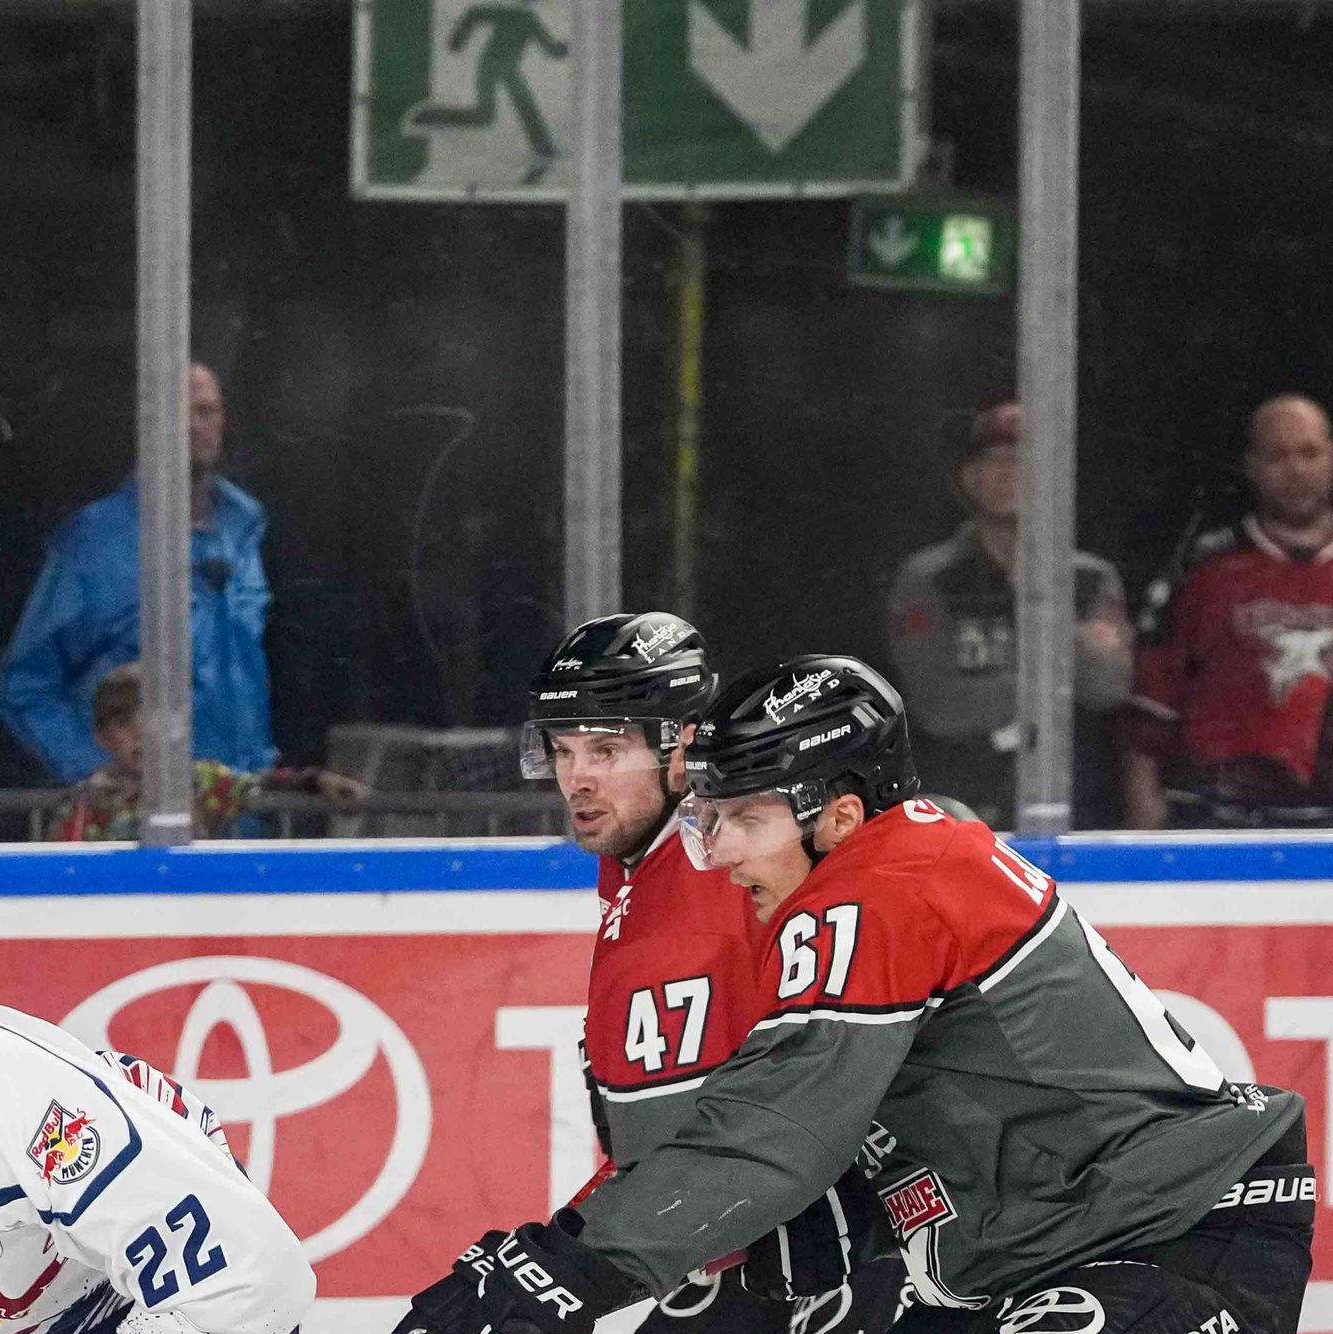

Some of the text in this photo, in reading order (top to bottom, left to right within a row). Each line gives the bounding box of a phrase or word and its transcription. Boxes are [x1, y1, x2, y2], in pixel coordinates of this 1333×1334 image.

[540, 690, 578, 700] BAUER
[670, 675, 700, 687] BAUER
[763, 668, 832, 720] Phantasia
[799, 724, 851, 751] BAUER
[777, 903, 861, 999] 61
[625, 977, 710, 1073] 47
[62, 1136, 95, 1179] MÜNCHEN
[125, 1194, 228, 1309] 22
